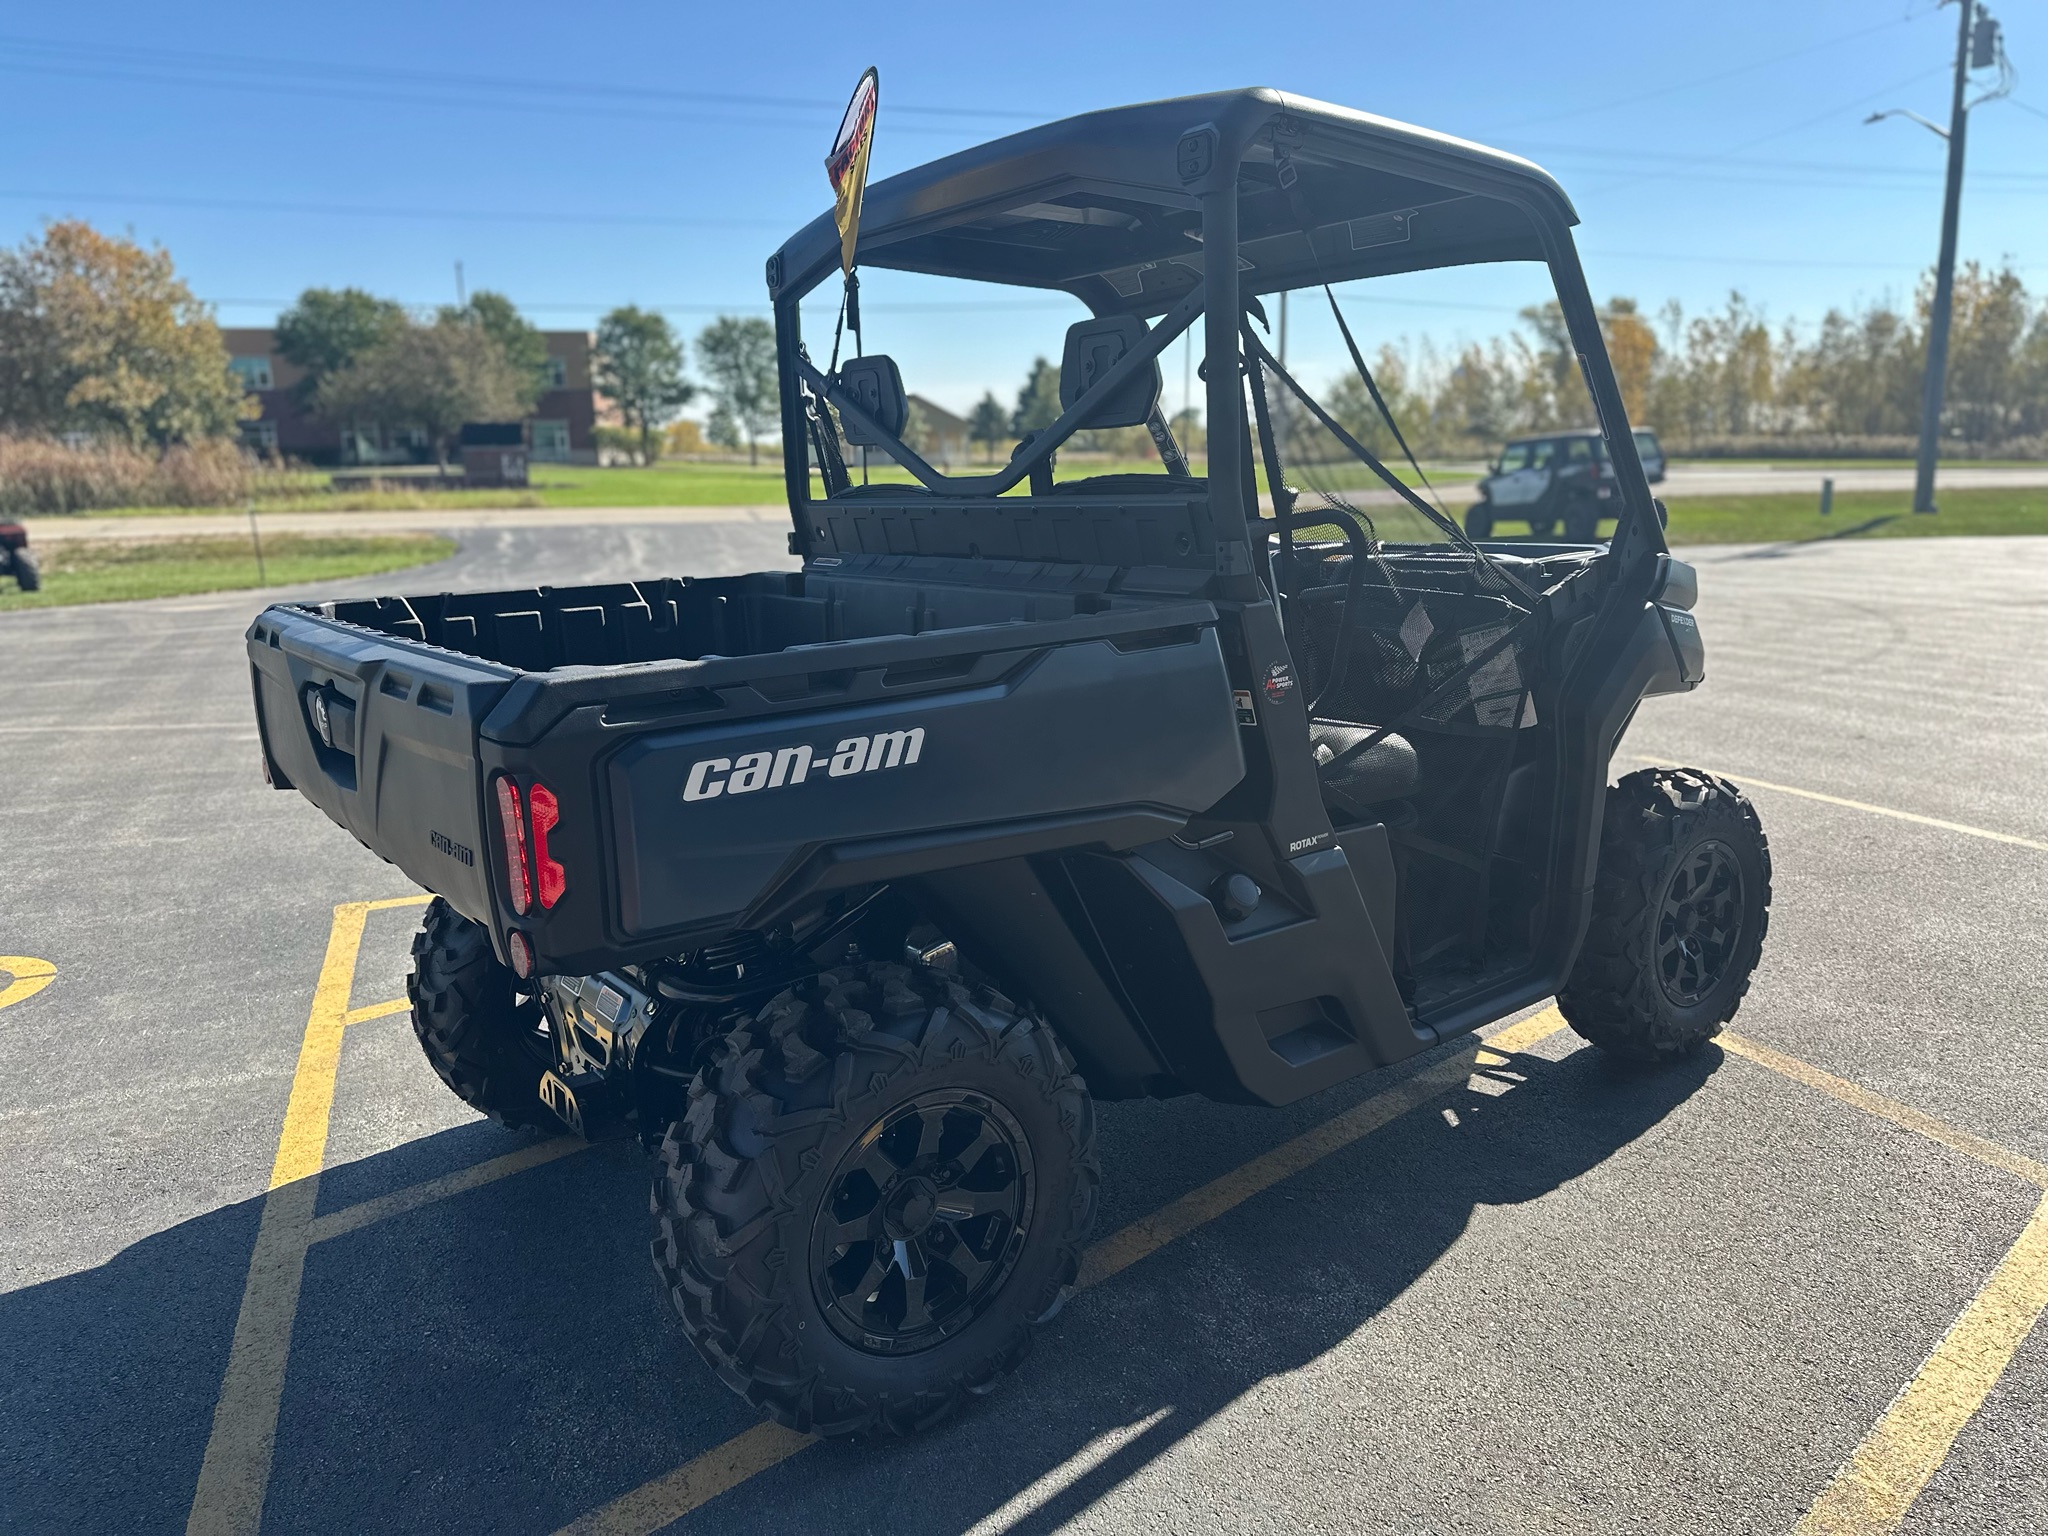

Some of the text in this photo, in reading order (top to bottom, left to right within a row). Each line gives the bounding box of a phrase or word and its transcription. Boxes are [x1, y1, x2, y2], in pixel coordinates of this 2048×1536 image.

[1671, 614, 1695, 627] DEFENDER
[682, 727, 925, 802] can-am
[430, 829, 474, 868] can-am
[1290, 835, 1318, 852] ROTAX
